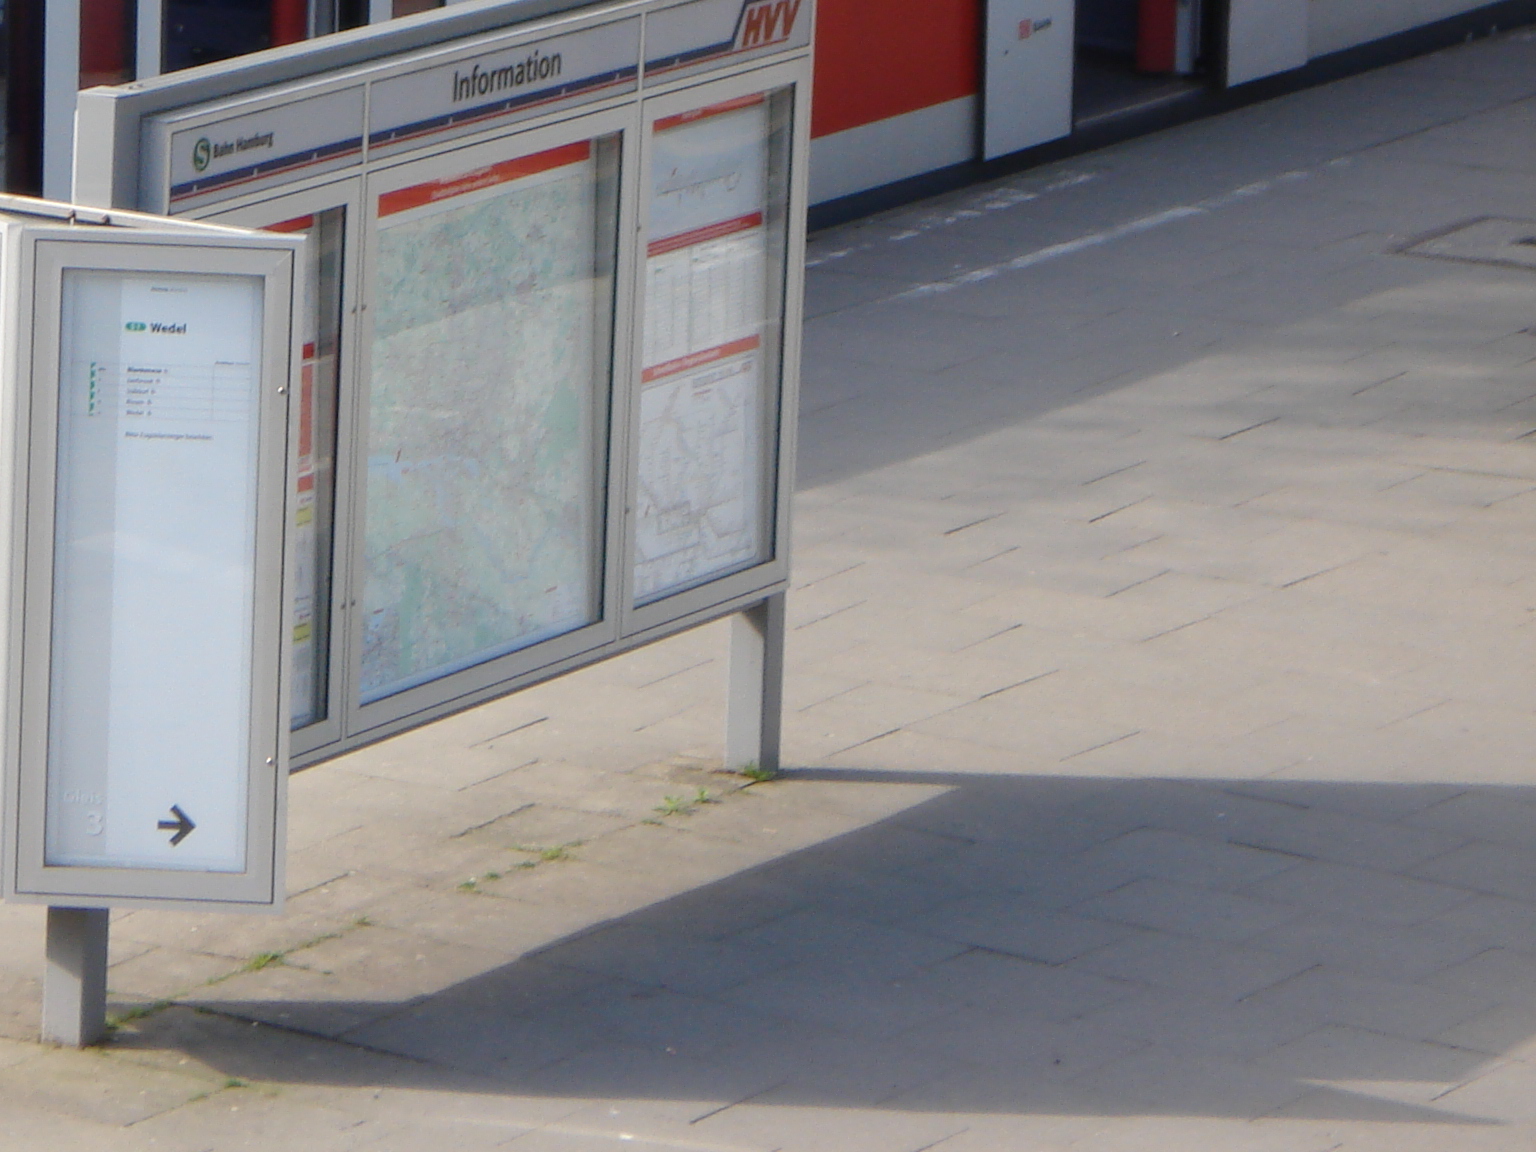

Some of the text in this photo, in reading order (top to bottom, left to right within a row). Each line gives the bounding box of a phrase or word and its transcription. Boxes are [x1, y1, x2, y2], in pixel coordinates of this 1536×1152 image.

[452, 49, 563, 103] Information
[213, 140, 235, 159] Bahn
[236, 131, 275, 152] Hamburg
[149, 322, 187, 335] Wedel
